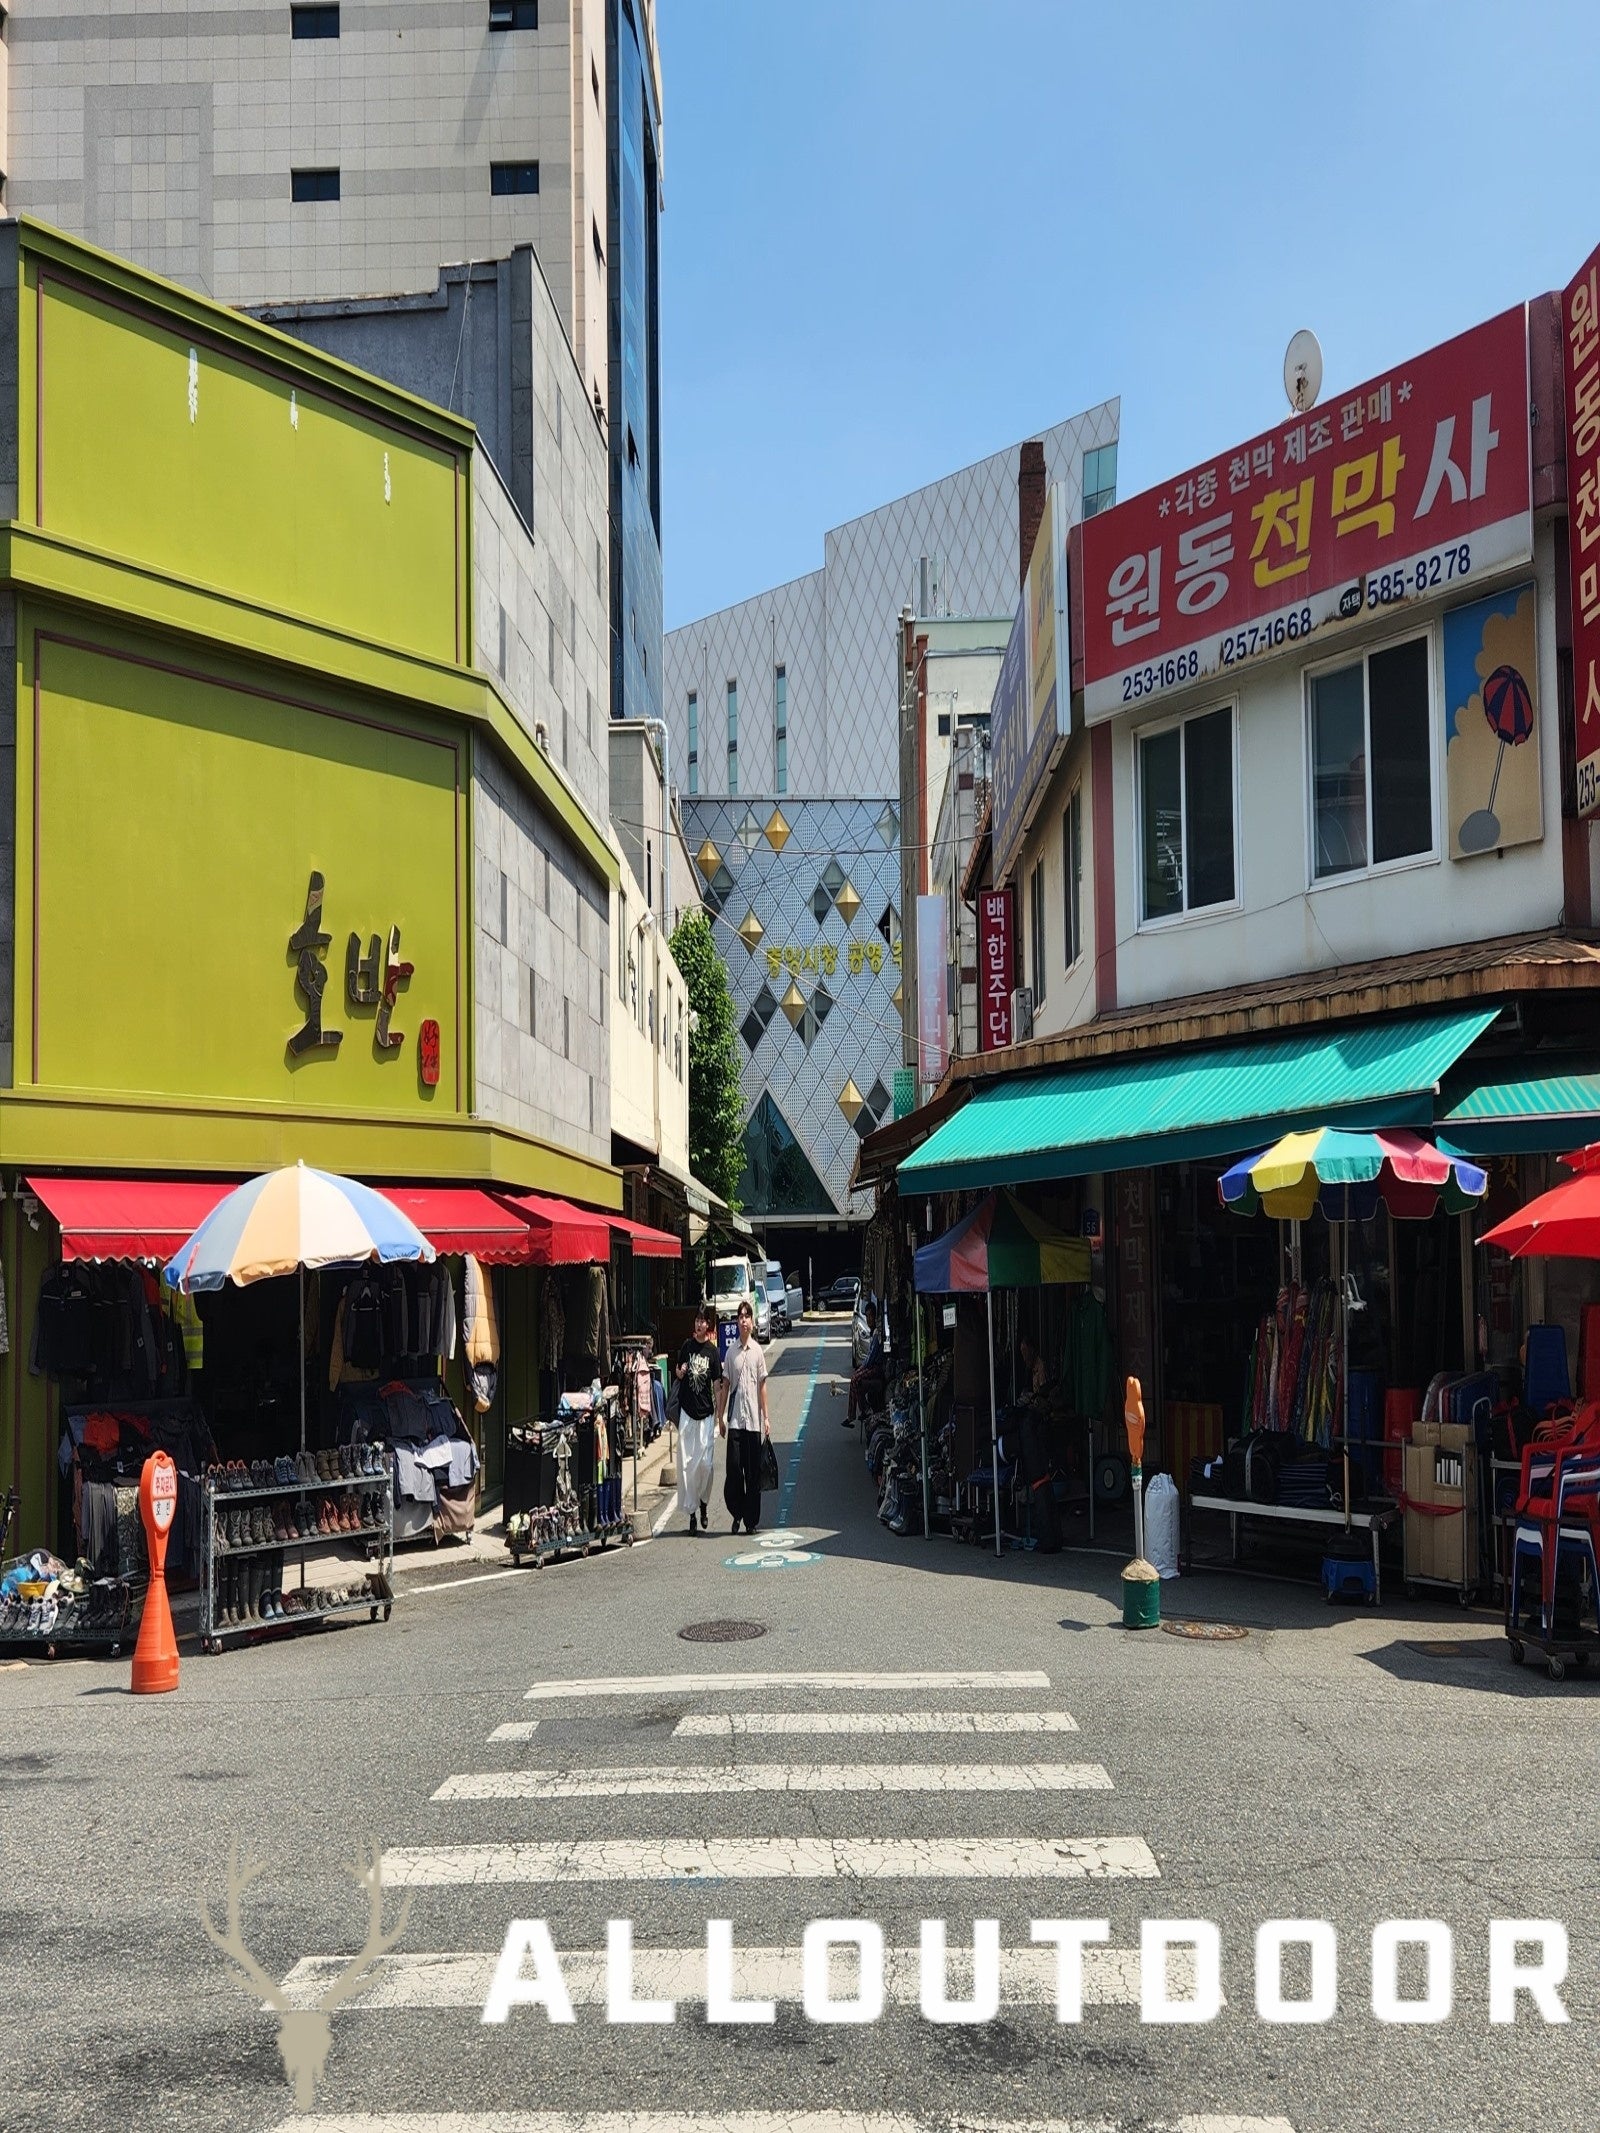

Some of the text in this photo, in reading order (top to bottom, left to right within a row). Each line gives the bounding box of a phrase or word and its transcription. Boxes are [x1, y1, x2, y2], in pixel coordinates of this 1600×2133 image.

[1175, 381, 1392, 516] 각종 천막 제조 판매
[1123, 650, 1199, 702] 253-1668
[1224, 607, 1312, 665] 257-1668
[1366, 543, 1471, 609] 585-8278
[767, 945, 838, 979] 중앙시장
[848, 942, 882, 975] 공영
[986, 896, 1009, 1046] 백합주단
